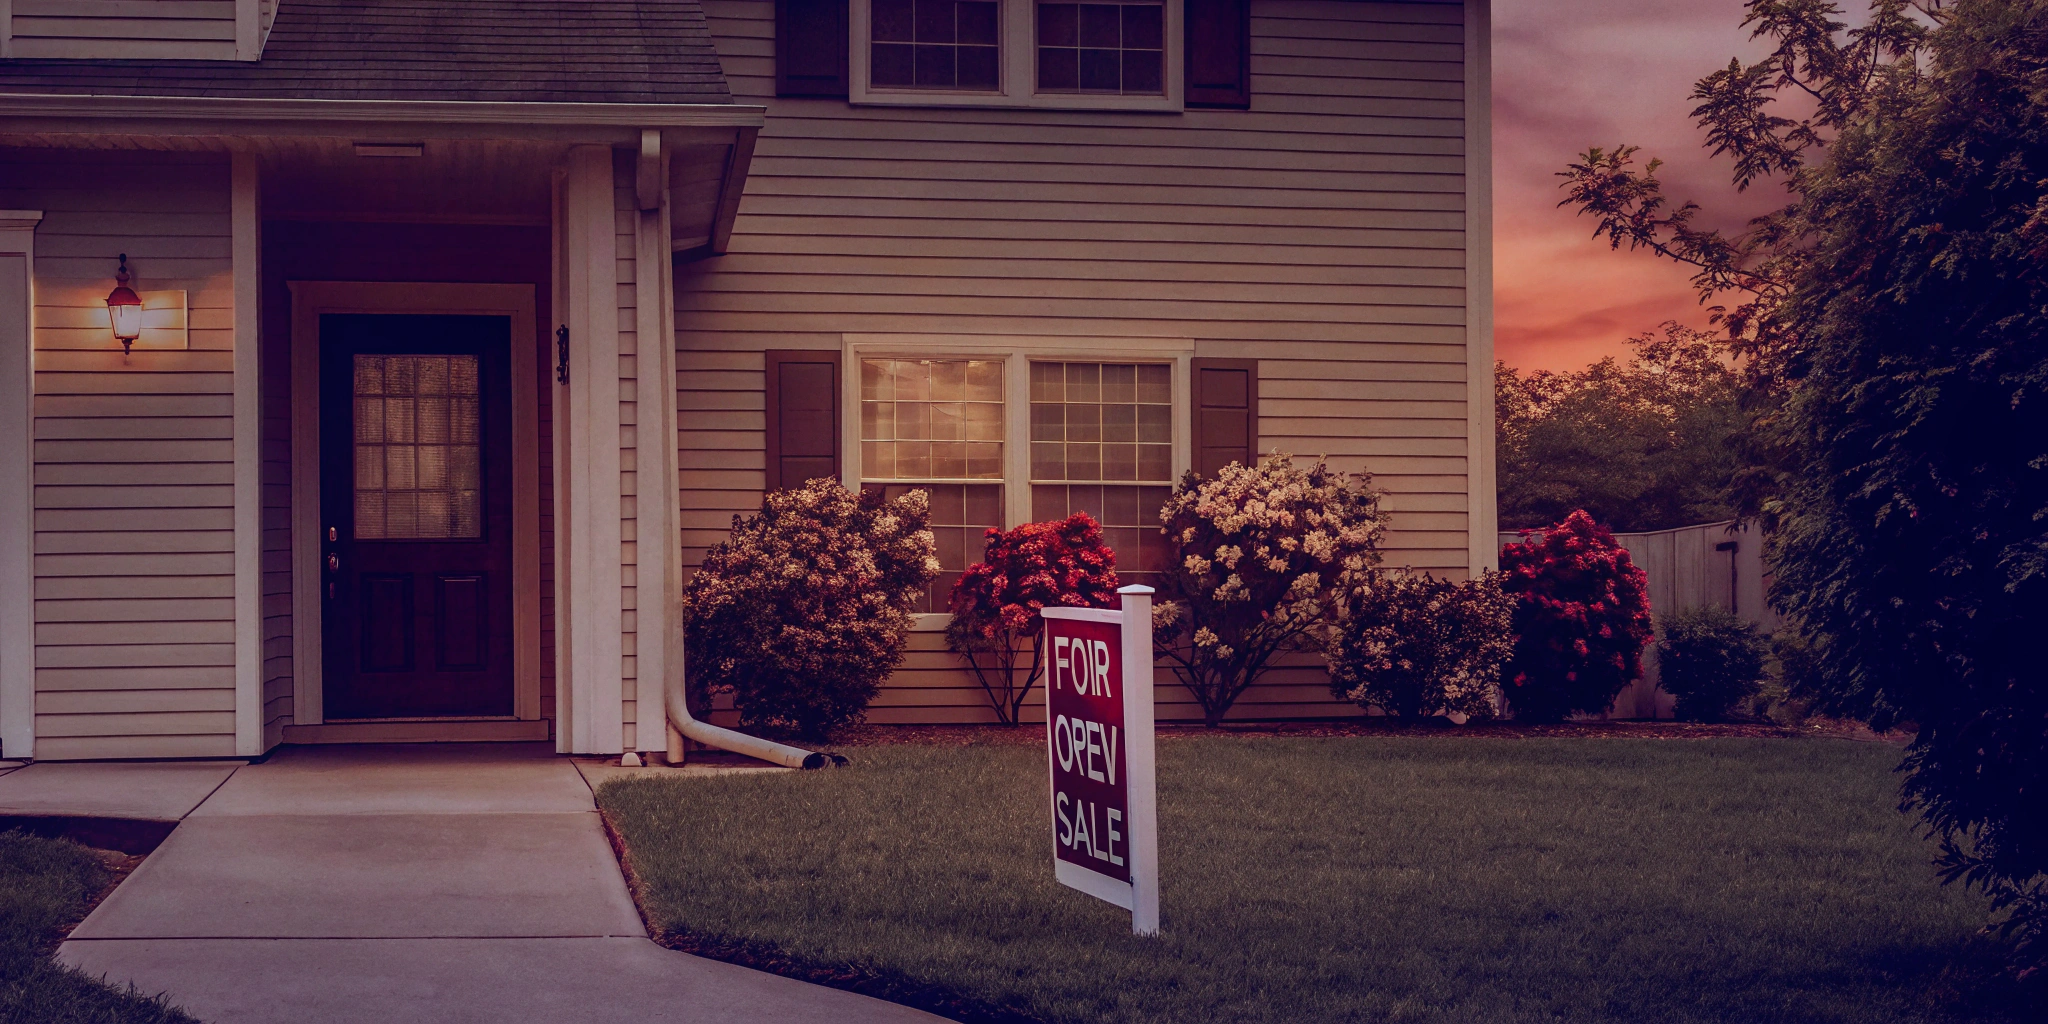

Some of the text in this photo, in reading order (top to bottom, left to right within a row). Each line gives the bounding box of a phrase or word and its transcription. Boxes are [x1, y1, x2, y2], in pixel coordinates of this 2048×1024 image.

[1054, 636, 1111, 697] FOIR
[1055, 714, 1117, 785] OPEV
[1056, 791, 1123, 866] SALE
